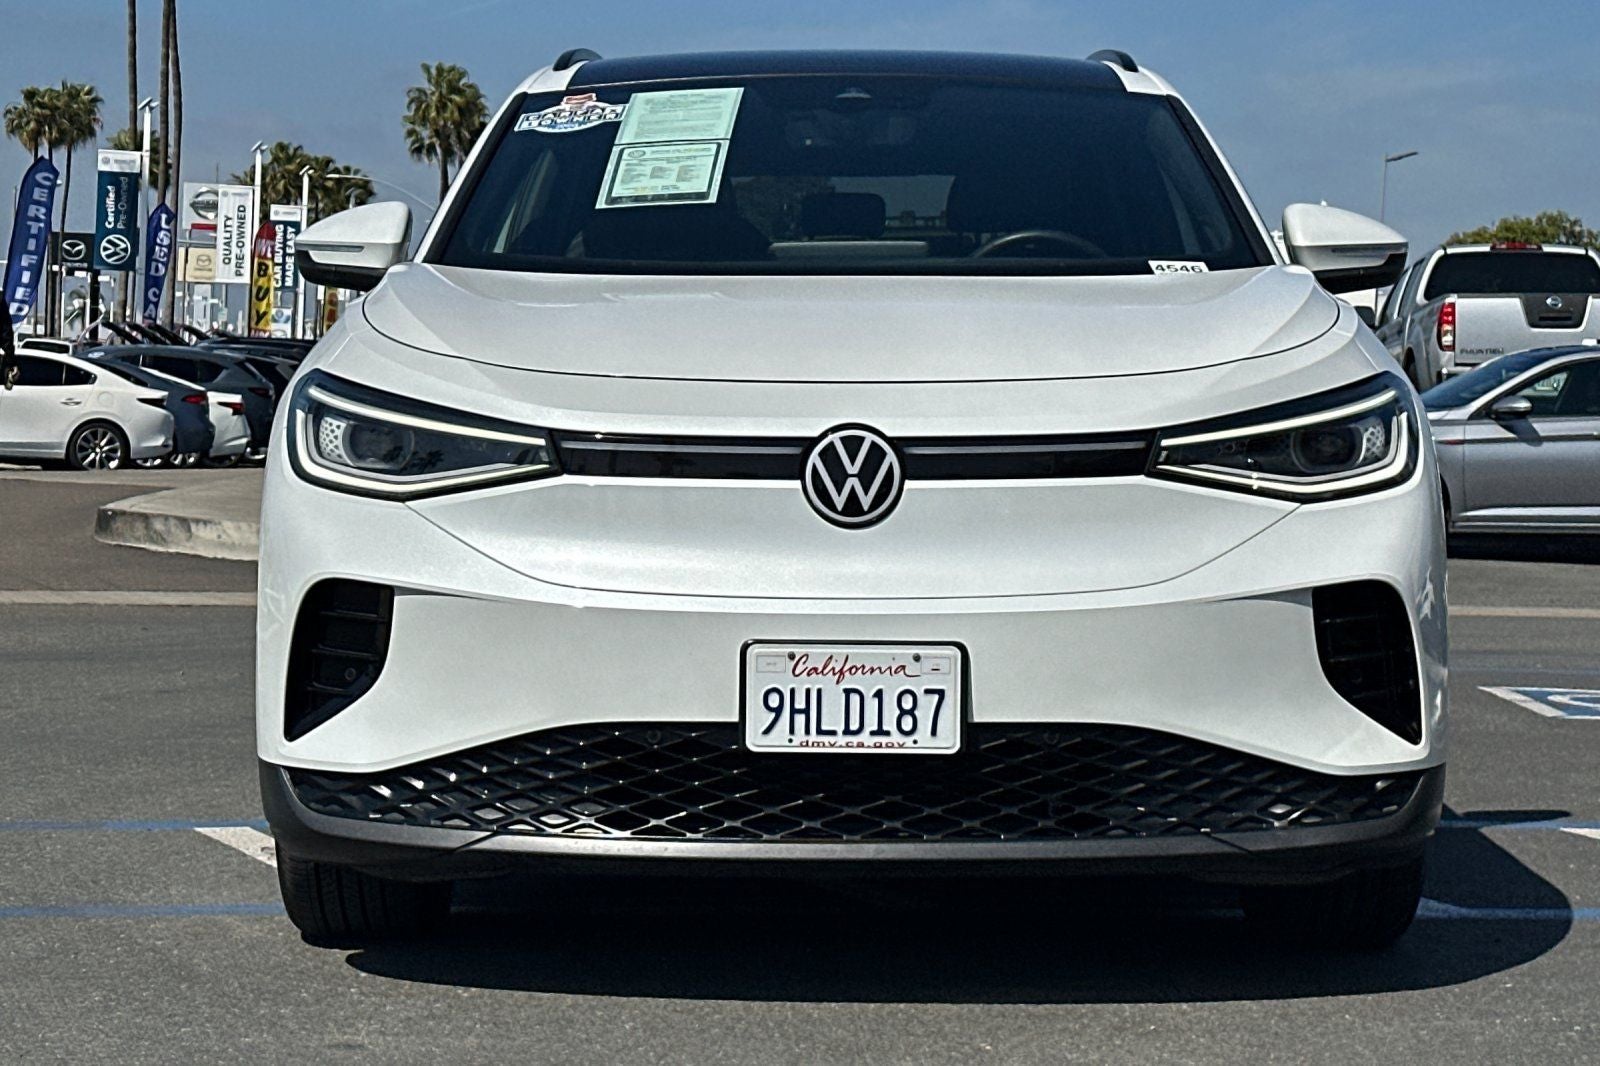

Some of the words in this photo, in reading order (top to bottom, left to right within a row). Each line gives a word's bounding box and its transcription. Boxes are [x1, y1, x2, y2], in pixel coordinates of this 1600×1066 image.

[105, 185, 116, 229] Certified
[117, 176, 128, 229] Pre-Owned
[9, 172, 54, 316] CERTIFIED
[223, 215, 233, 265] QUALITY
[235, 204, 247, 277] PRE-OWNED
[274, 223, 284, 263] BUYING
[286, 225, 296, 254] EASY
[273, 266, 283, 288] CAR
[284, 255, 294, 287] MADE
[255, 262, 270, 327] BUY
[791, 653, 921, 685] California
[761, 686, 946, 738] 9HLD187
[799, 739, 907, 749] dmv.ca.gov
